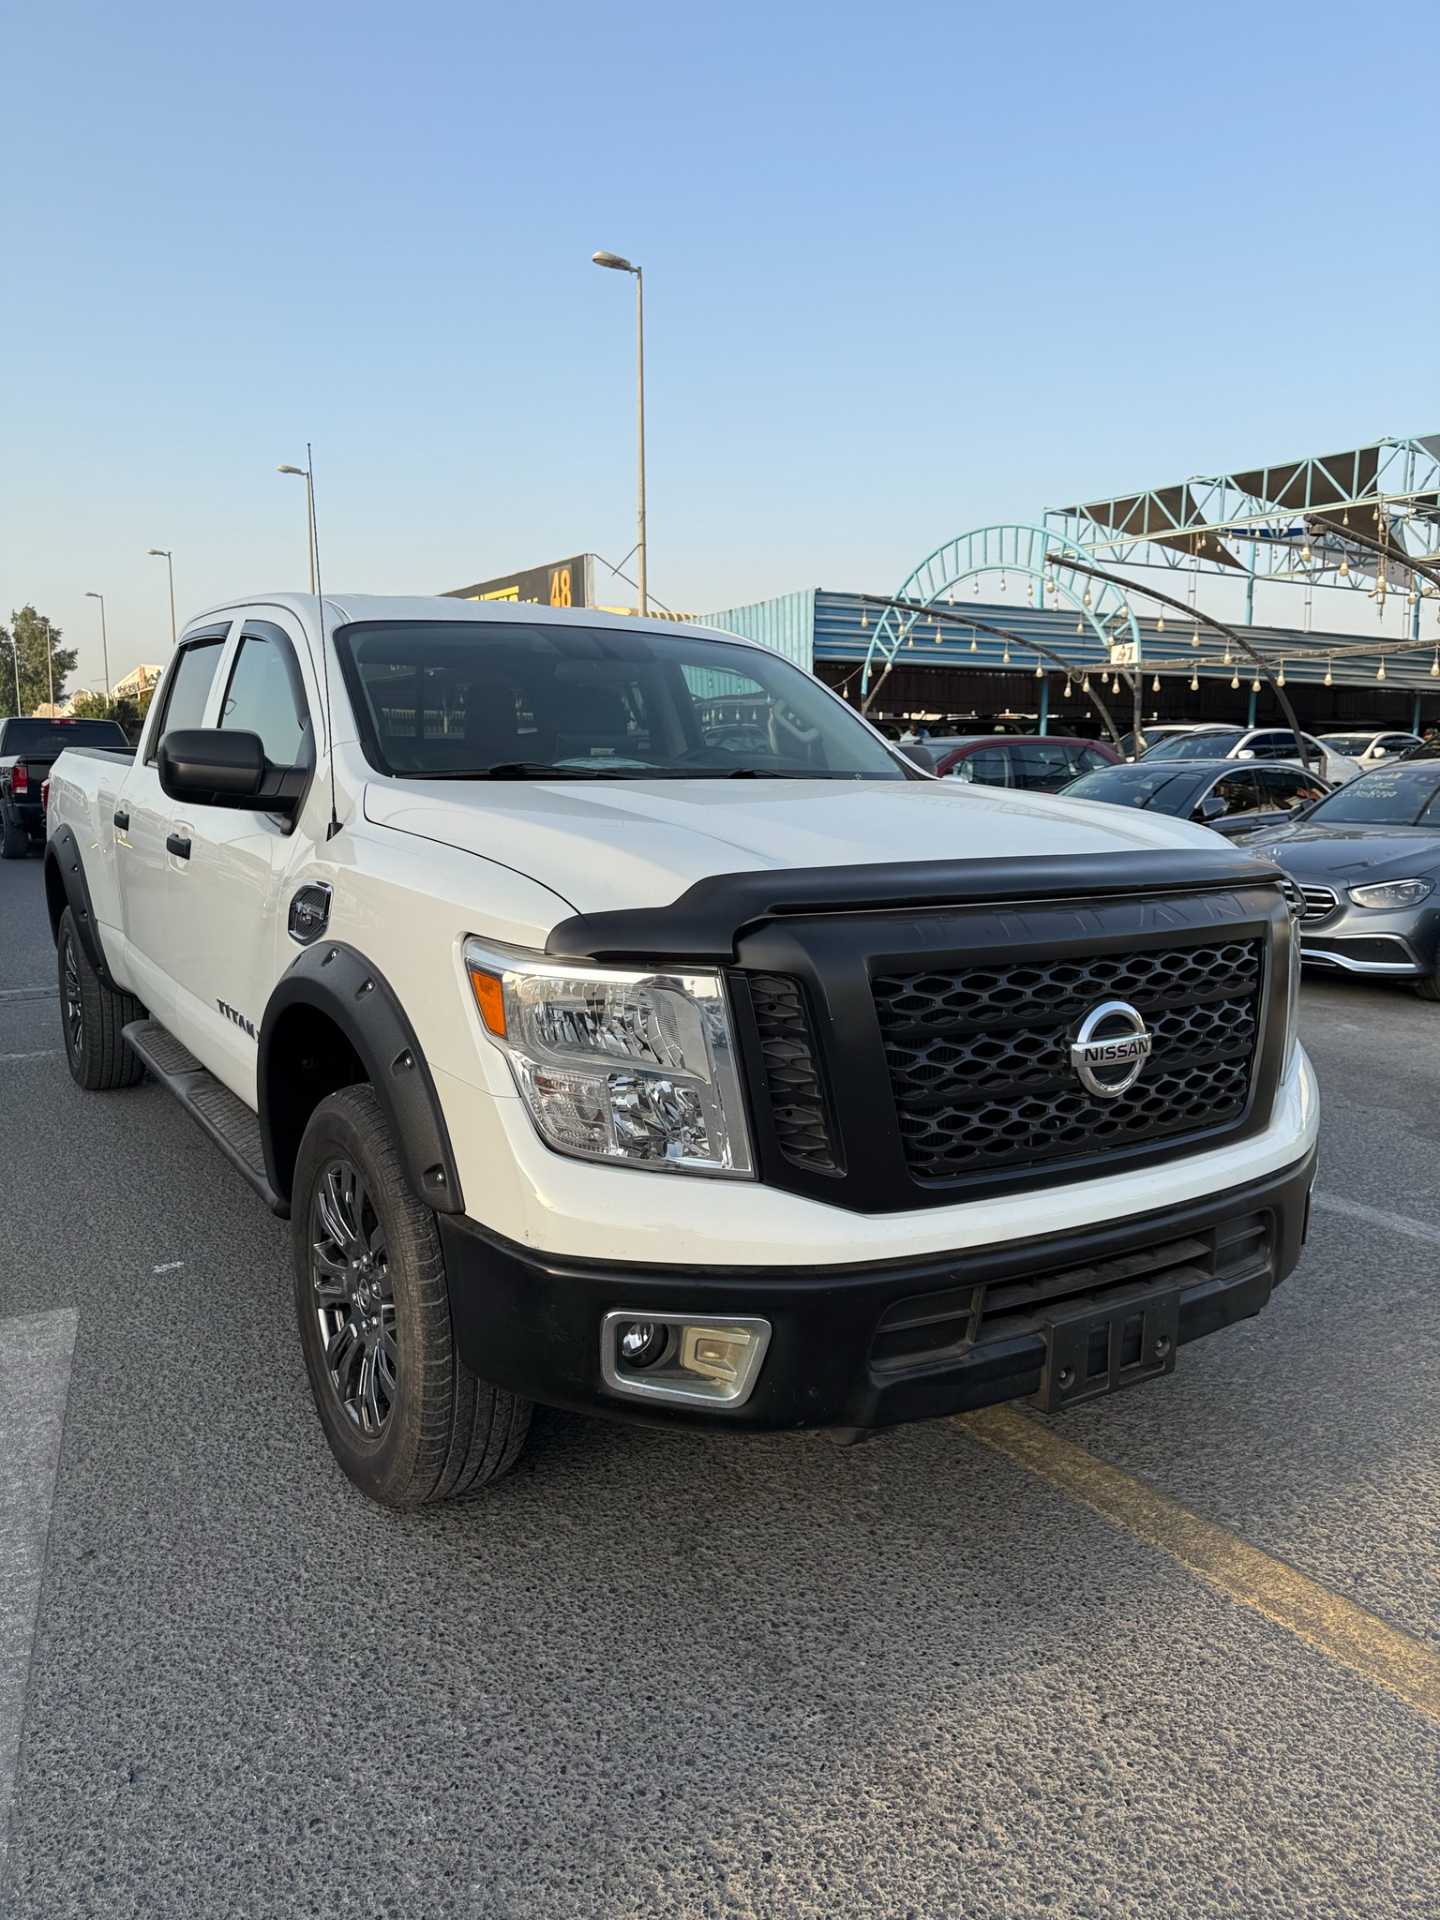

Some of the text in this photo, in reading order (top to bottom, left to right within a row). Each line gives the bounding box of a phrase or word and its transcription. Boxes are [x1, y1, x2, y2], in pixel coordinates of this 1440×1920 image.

[551, 569, 572, 608] 48
[900, 894, 1250, 945] TITAN
[216, 998, 256, 1041] TITAN
[1084, 1039, 1150, 1062] NISSAN
